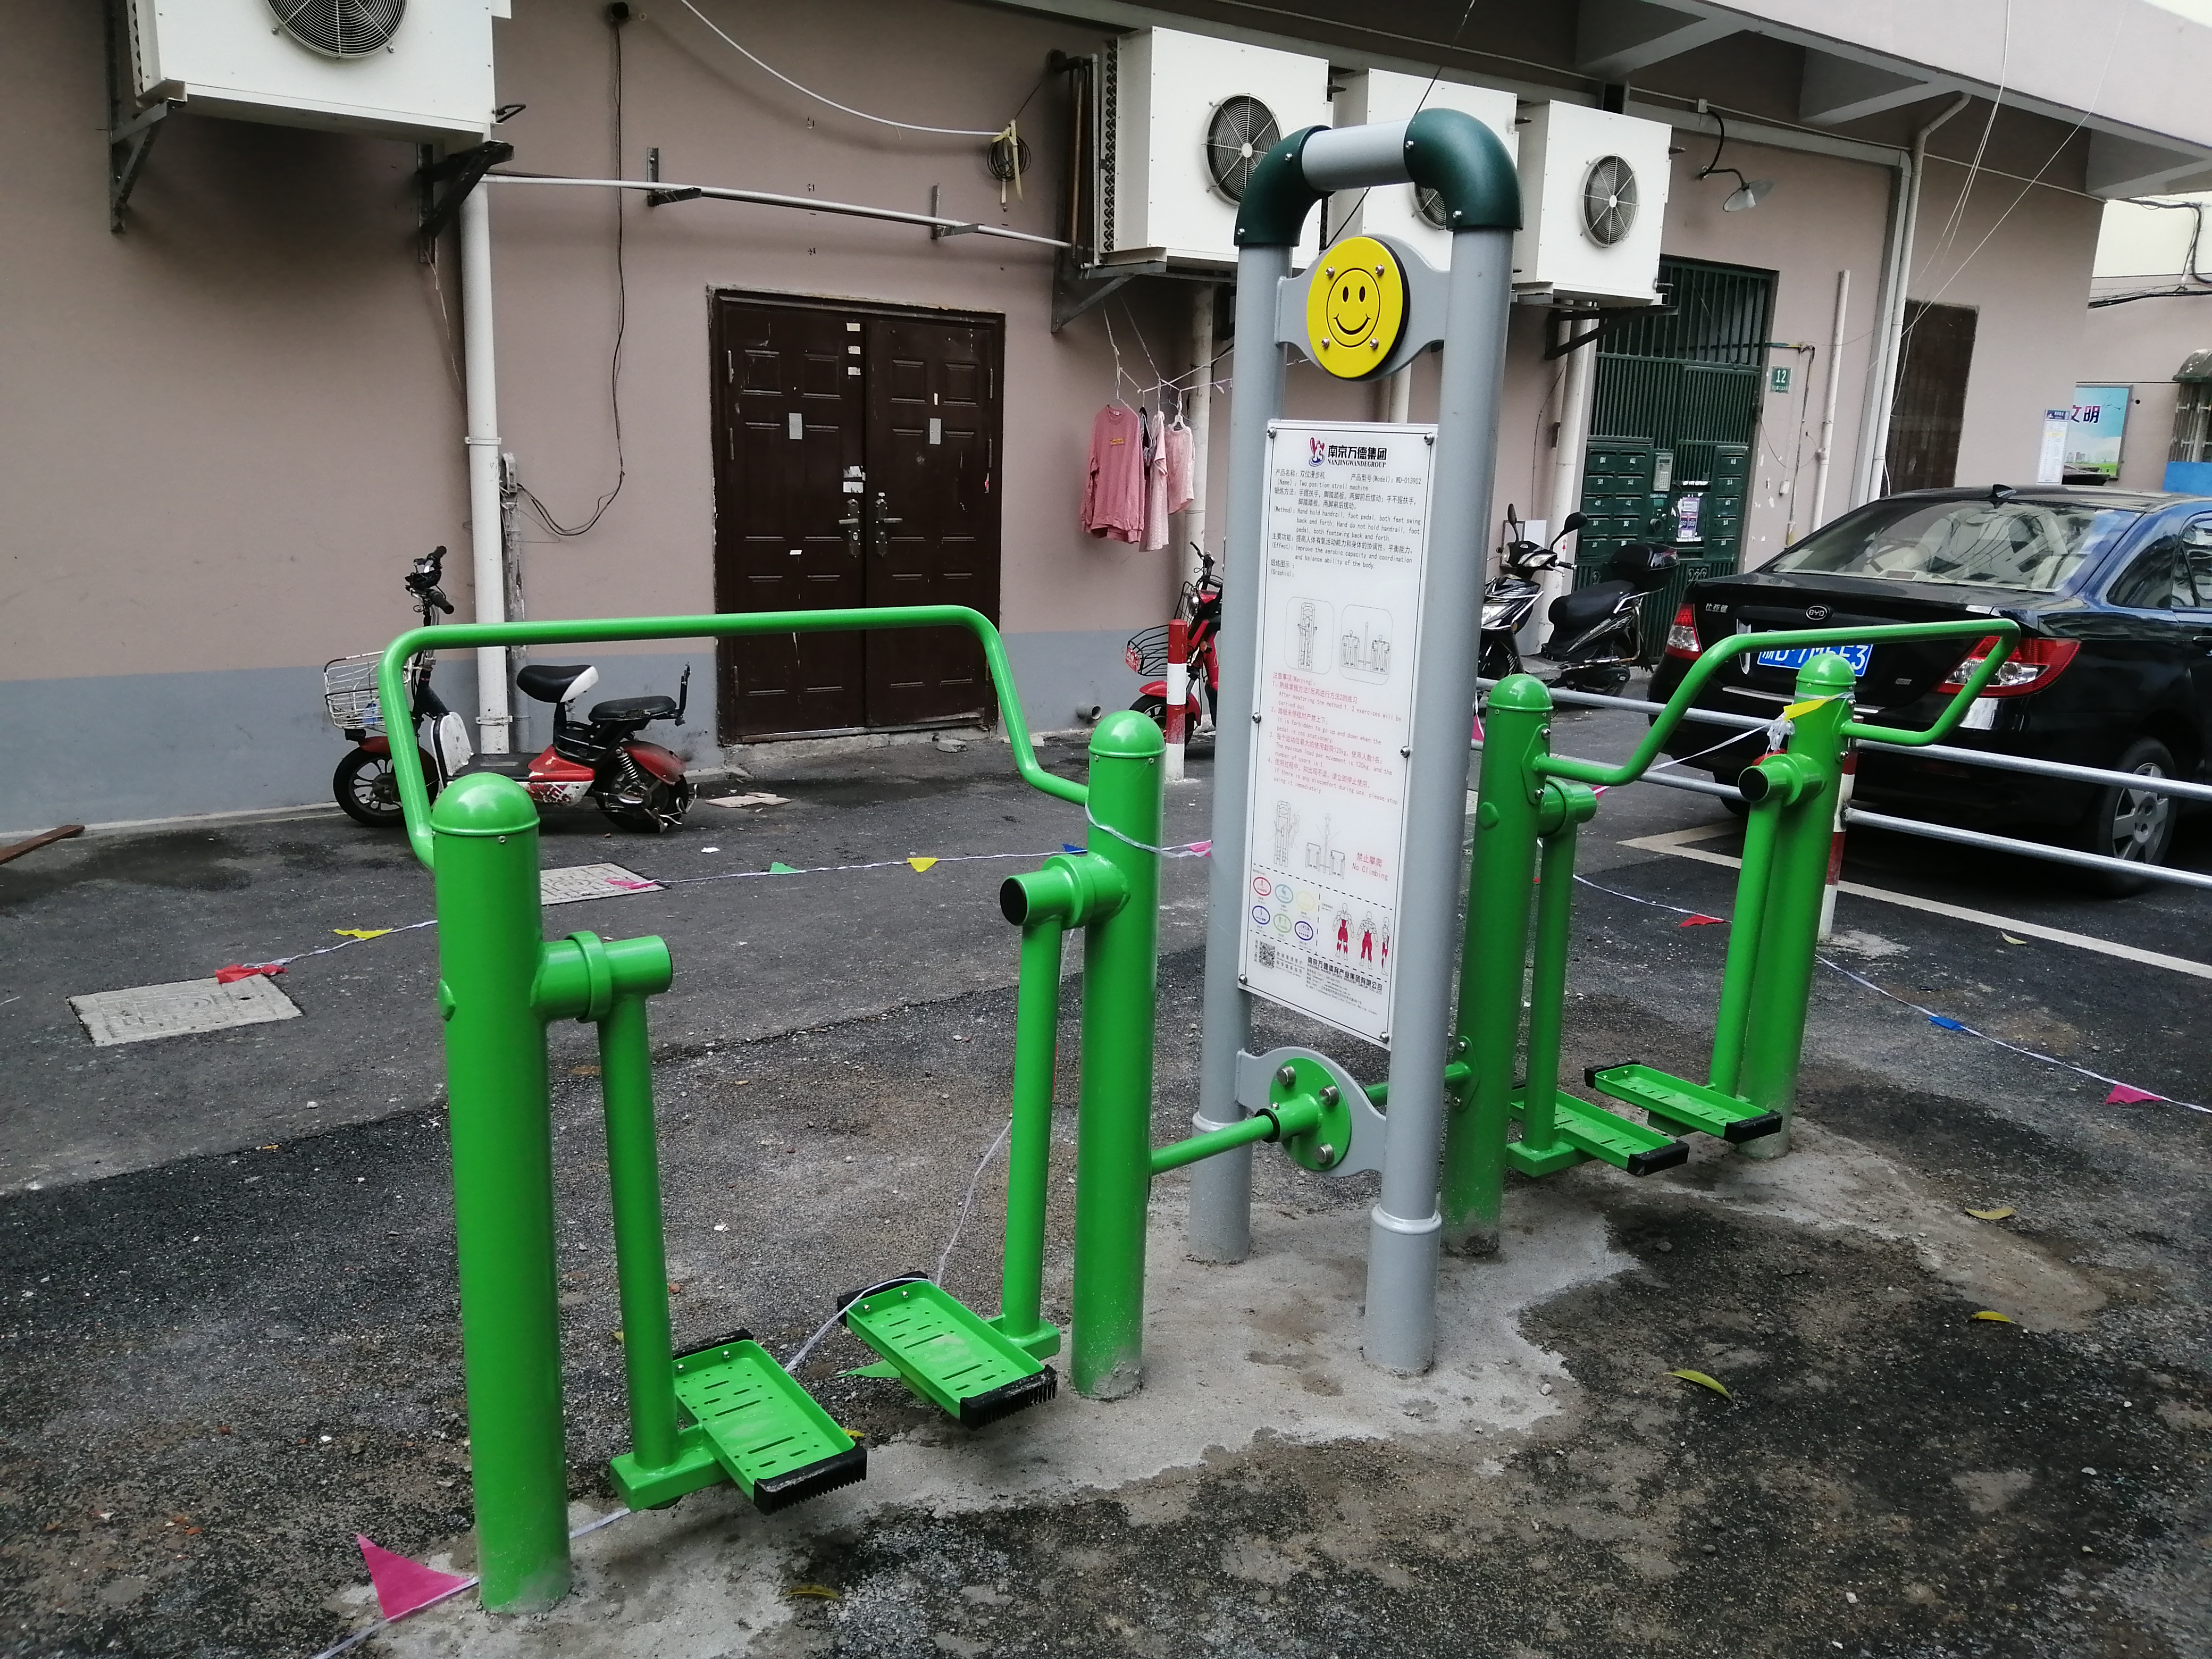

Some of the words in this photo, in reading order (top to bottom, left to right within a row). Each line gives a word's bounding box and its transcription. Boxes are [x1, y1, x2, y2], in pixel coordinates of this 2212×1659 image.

[1776, 370, 1786, 383] 12
[2071, 405, 2101, 423] 文明
[1328, 445, 1387, 460] 南京万德集团
[1327, 459, 1386, 467] NANJINGWANDEGROUP
[1325, 557, 1343, 566] ability
[1379, 555, 1412, 563] coordination
[1705, 602, 1728, 613] 比亚迪
[1293, 694, 1314, 705] mastering
[1356, 708, 1380, 717] exercises
[1292, 719, 1313, 729] forbidden
[1338, 784, 1354, 794] during
[1369, 792, 1385, 801] please
[1356, 852, 1382, 868] 禁止攀爬
[1352, 862, 1359, 871] No
[1362, 866, 1388, 881] Climbing
